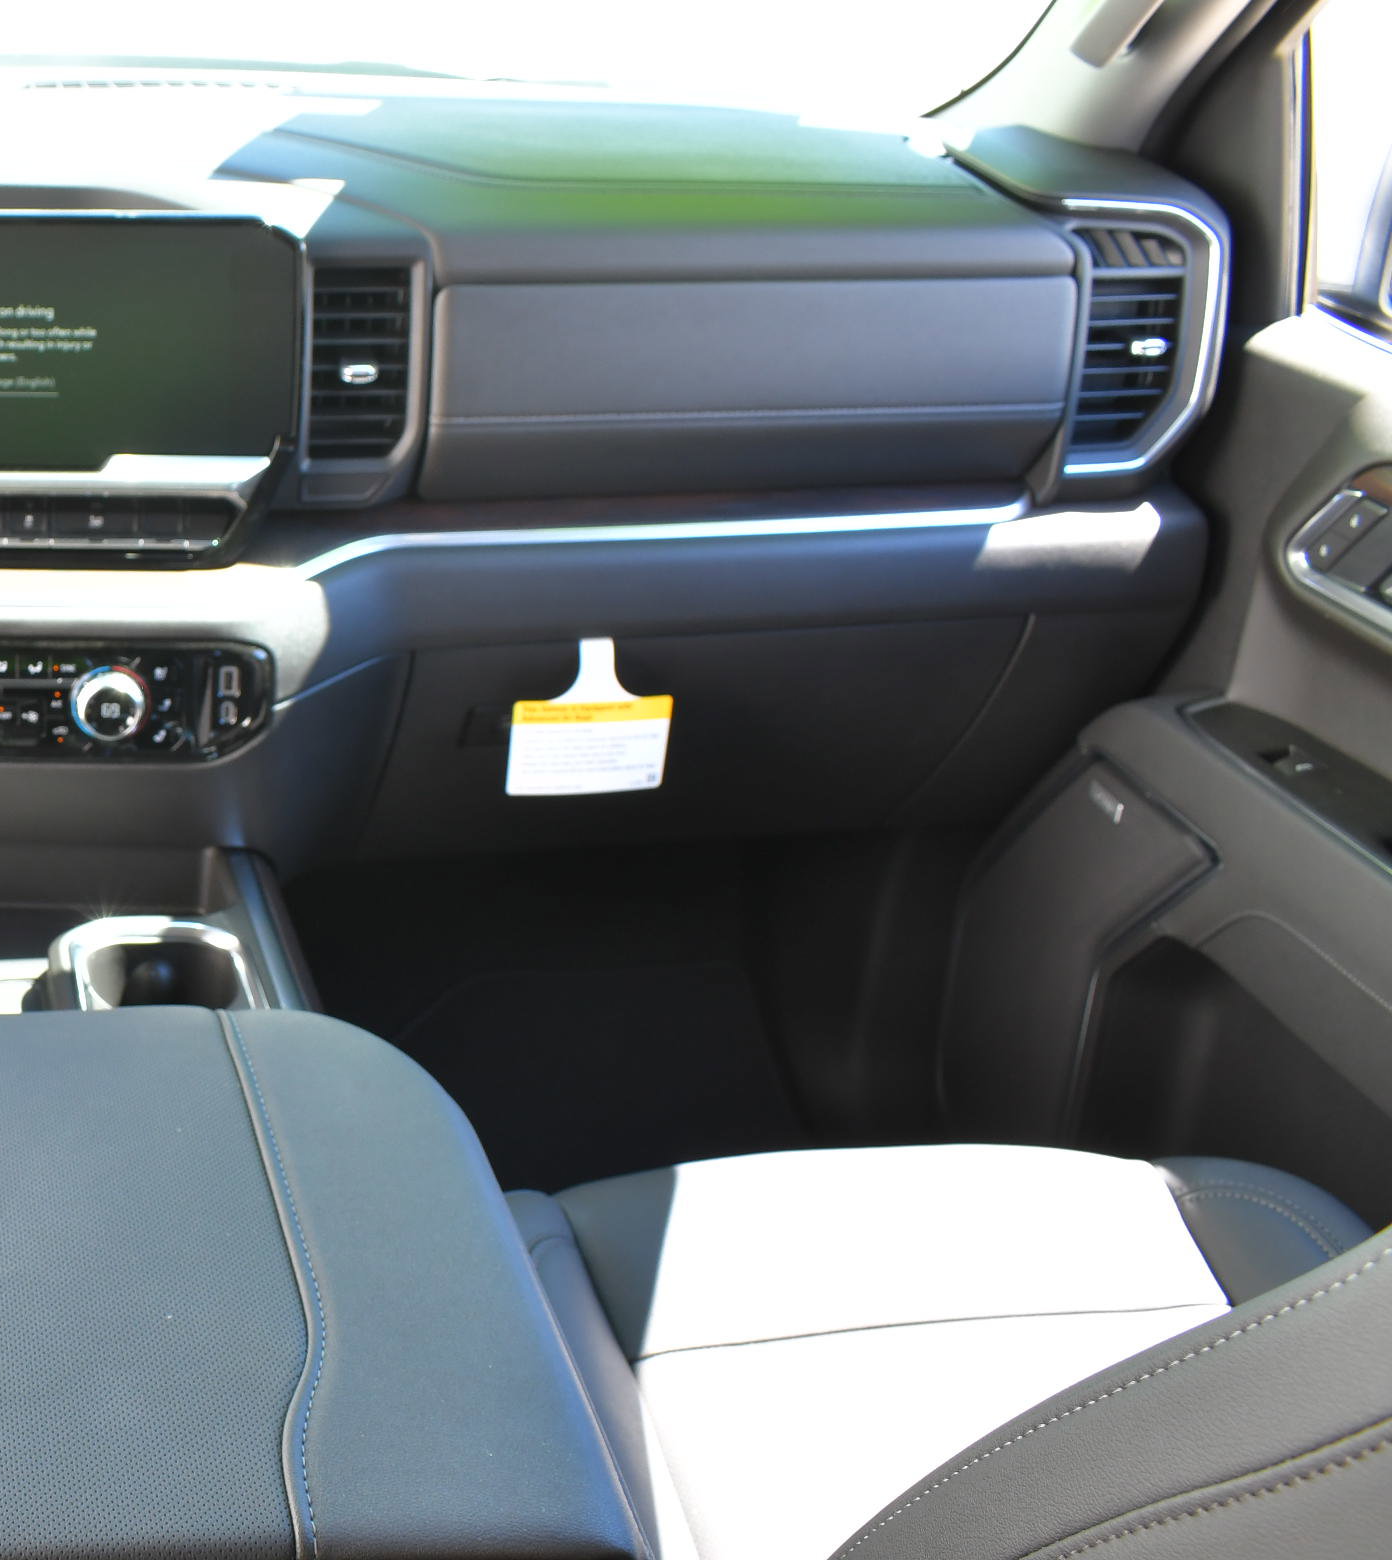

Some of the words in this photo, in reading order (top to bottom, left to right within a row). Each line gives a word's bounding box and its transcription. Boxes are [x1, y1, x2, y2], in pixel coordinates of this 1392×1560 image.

[0, 307, 14, 319] on
[15, 304, 55, 322] driving
[30, 327, 46, 338] too
[47, 325, 72, 338] often
[73, 325, 97, 339] while
[7, 338, 46, 352] resulting
[82, 341, 93, 351] or
